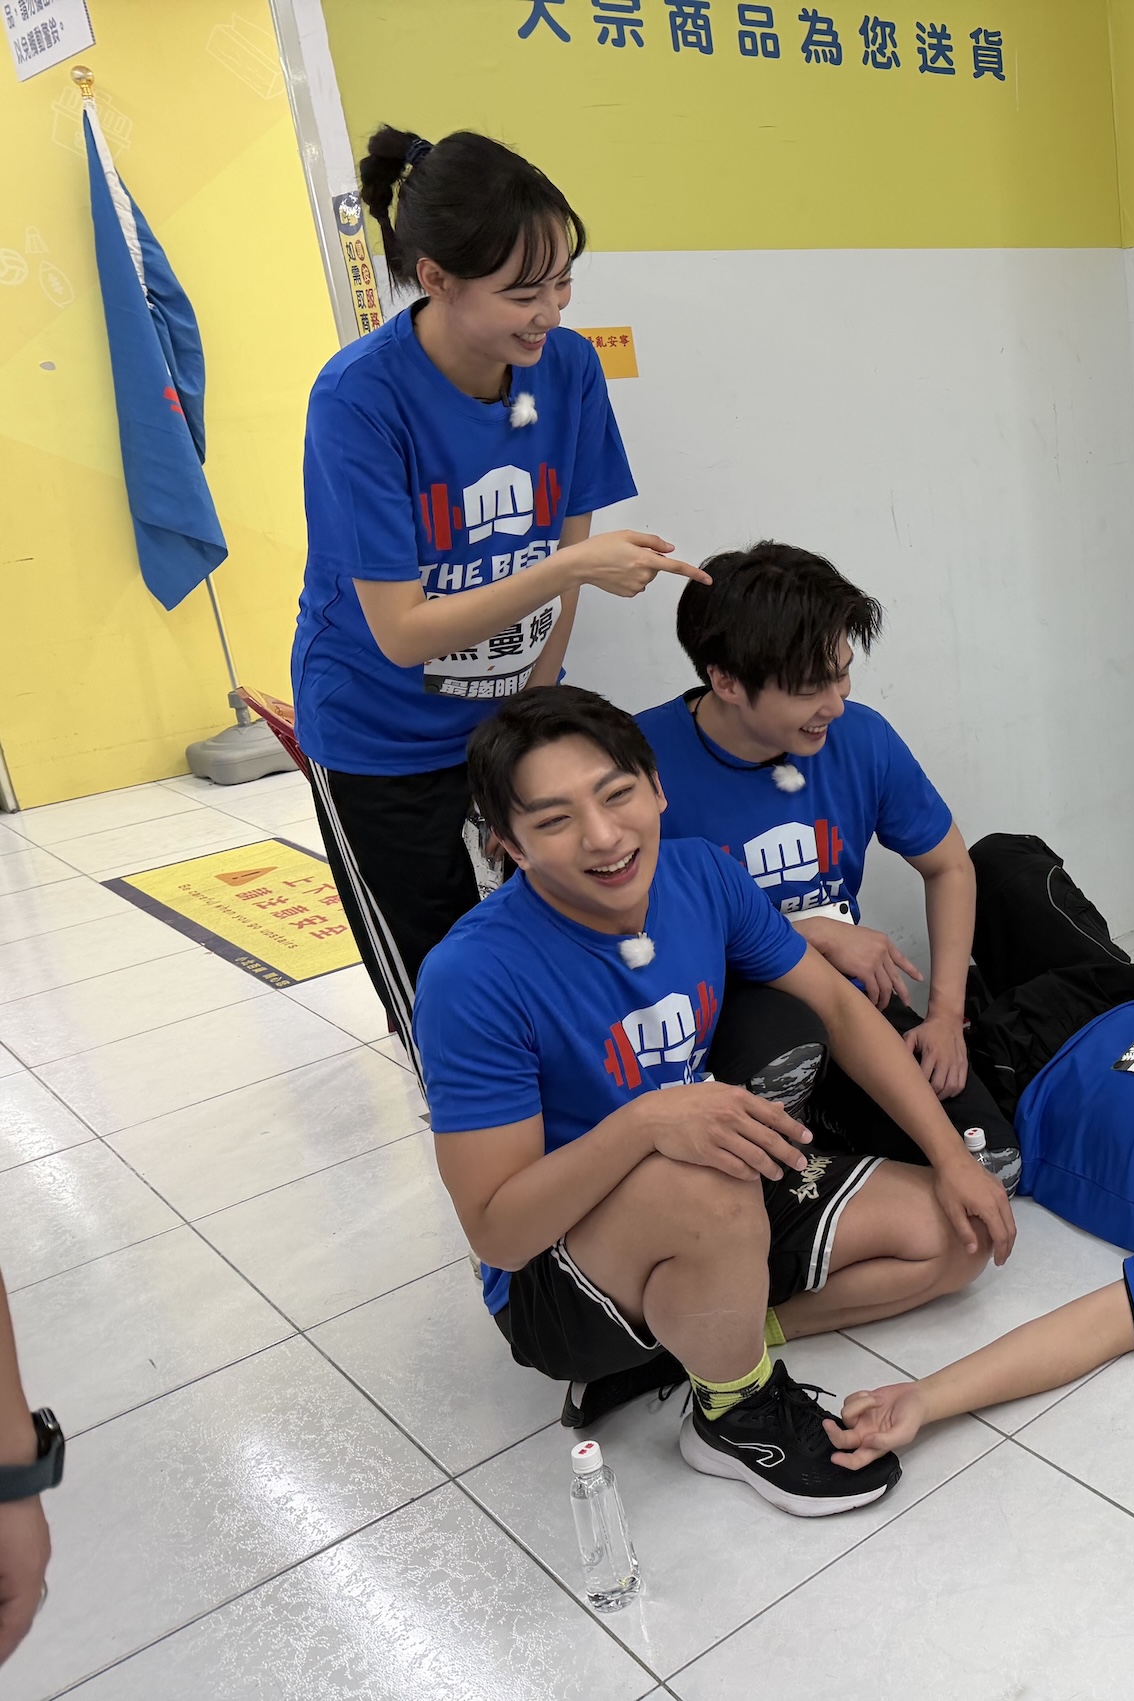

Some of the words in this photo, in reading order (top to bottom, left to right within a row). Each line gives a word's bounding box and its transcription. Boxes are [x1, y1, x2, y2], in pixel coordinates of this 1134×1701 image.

[517, 0, 1006, 82] 大宗商品為您送貨
[419, 558, 483, 590] THE
[215, 903, 236, 916] when
[231, 914, 252, 924] you
[246, 922, 262, 930] go
[260, 928, 298, 949] upstairs
[235, 887, 347, 939] 請注意安全
